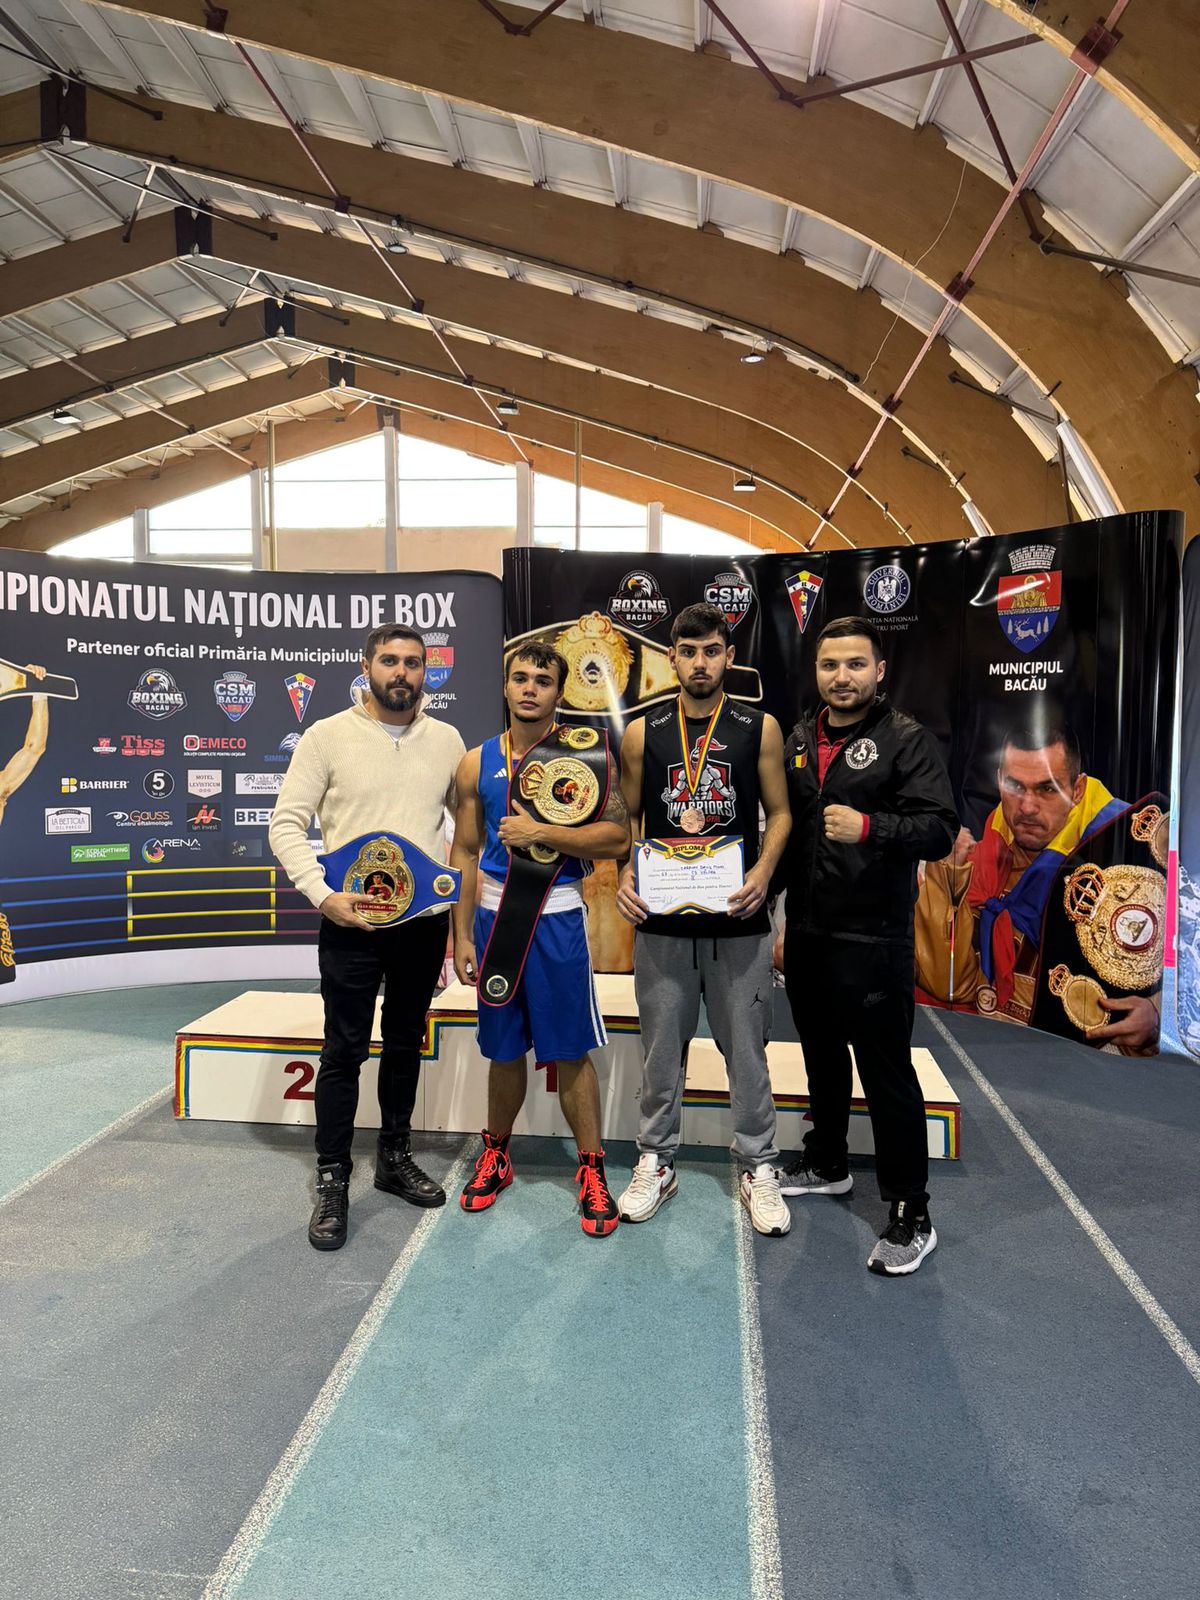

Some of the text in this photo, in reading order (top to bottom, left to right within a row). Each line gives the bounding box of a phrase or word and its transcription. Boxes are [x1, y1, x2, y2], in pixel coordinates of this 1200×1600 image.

[706, 587, 750, 602] CSM
[0, 570, 456, 638] PIONATUL NAȚIONAL DE BOX
[610, 599, 667, 613] BOXING
[711, 603, 747, 612] ACAU
[66, 638, 364, 665] Partener oficial Primăria Municipiului
[989, 660, 1064, 675] MUNICIPIUL
[215, 683, 254, 696] CSM
[1004, 674, 1047, 691] BACĂU
[132, 692, 183, 705] BOXING
[426, 700, 448, 709] ACĂU
[120, 735, 165, 749] Tiss
[186, 737, 247, 750] DEMECO
[79, 780, 128, 790] BARRIER
[152, 772, 166, 790] 5
[152, 839, 201, 848] ARENA
[283, 1061, 315, 1100] 2
